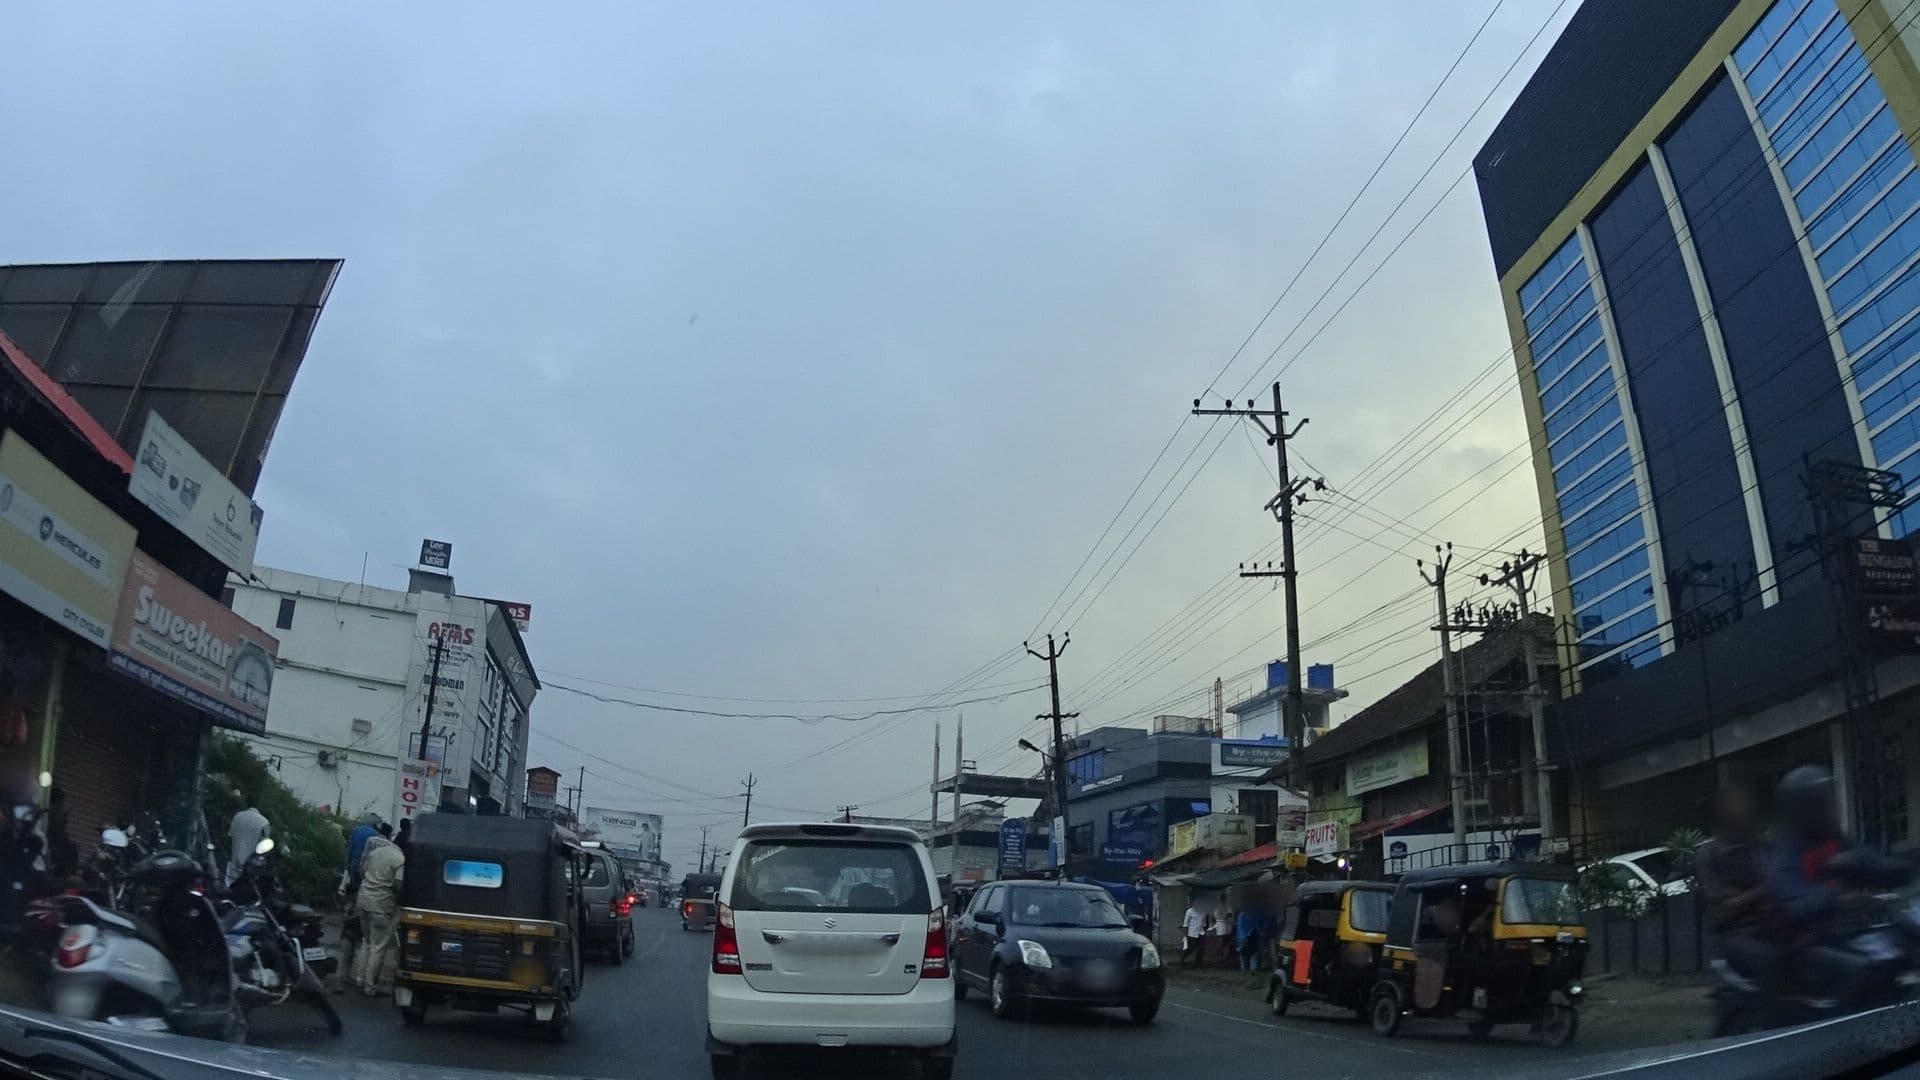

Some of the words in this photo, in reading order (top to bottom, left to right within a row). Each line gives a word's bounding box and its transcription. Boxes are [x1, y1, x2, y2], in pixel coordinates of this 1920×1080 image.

[54, 531, 101, 568] HERCULES
[134, 584, 232, 671] Sweekar
[441, 622, 462, 631] HOTEL
[1306, 823, 1336, 845] FRUITS
